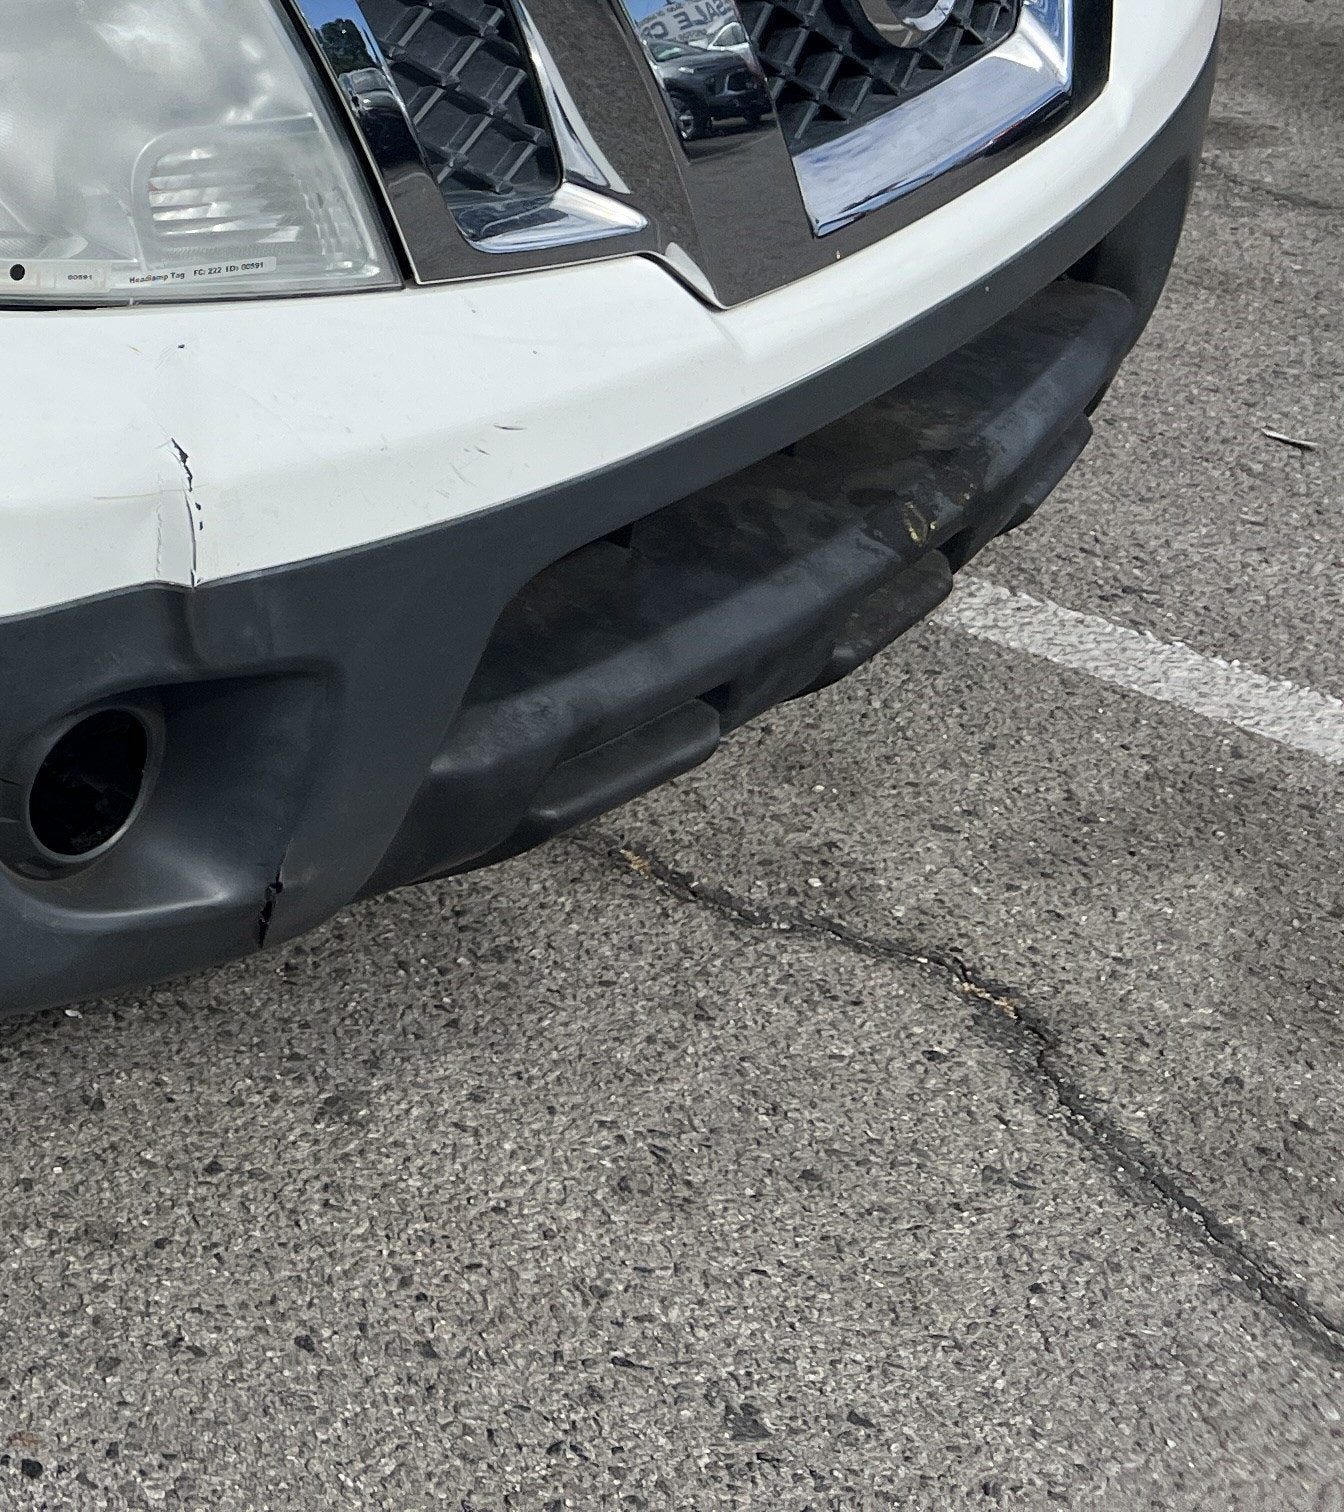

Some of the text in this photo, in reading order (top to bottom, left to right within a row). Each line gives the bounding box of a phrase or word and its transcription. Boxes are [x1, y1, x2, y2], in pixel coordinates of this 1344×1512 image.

[129, 274, 169, 284] Headlamp
[170, 271, 186, 280] Tag
[207, 266, 222, 275] 222
